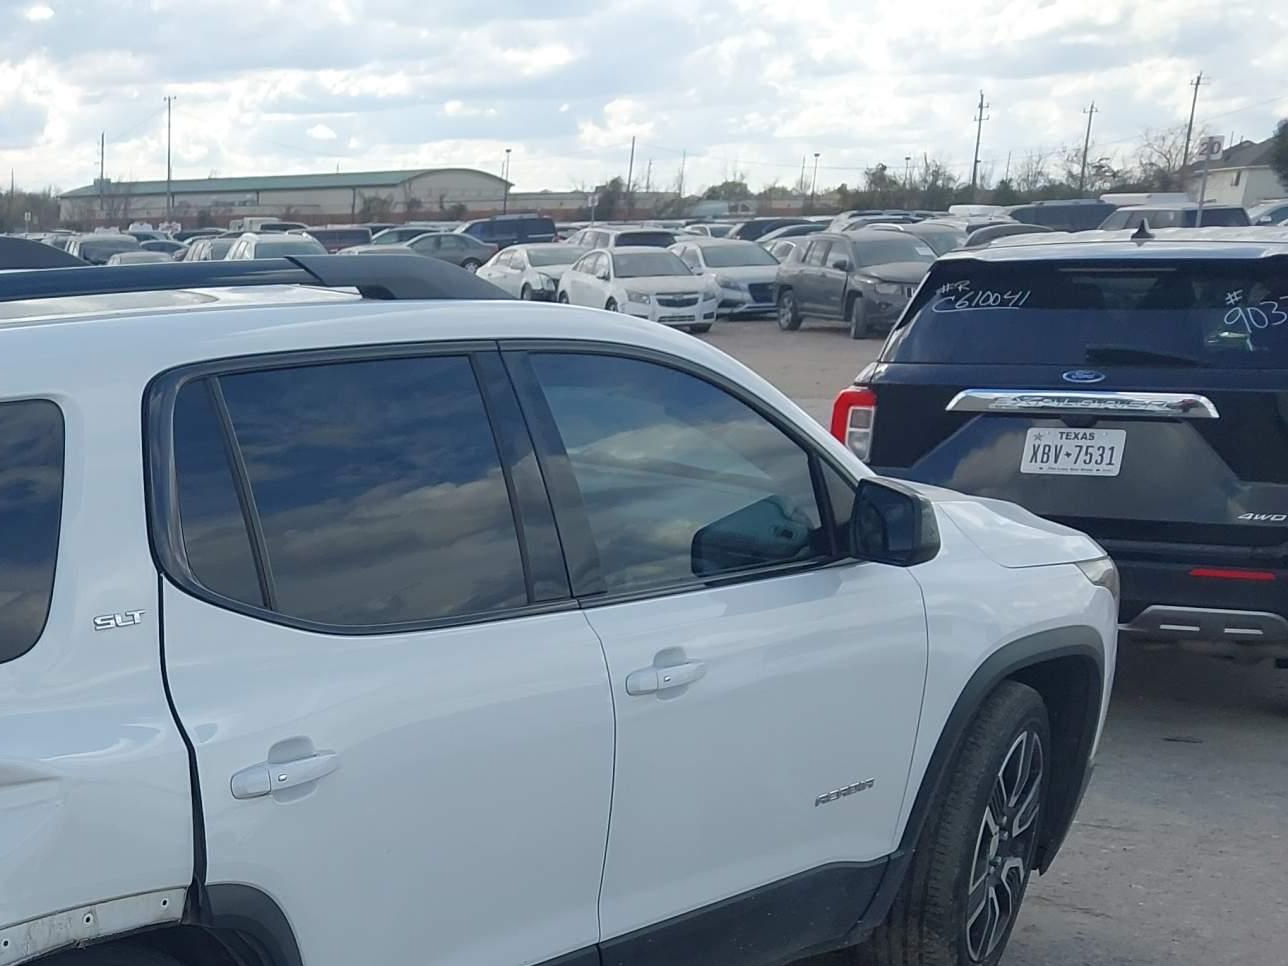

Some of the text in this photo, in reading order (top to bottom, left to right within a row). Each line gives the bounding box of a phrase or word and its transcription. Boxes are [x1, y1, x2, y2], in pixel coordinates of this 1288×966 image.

[1199, 141, 1221, 155] 20
[932, 290, 1031, 312] C610041
[1224, 296, 1288, 333] 903
[1059, 431, 1095, 441] TEXAS
[1237, 512, 1288, 521] 4WD
[92, 609, 146, 631] SLT
